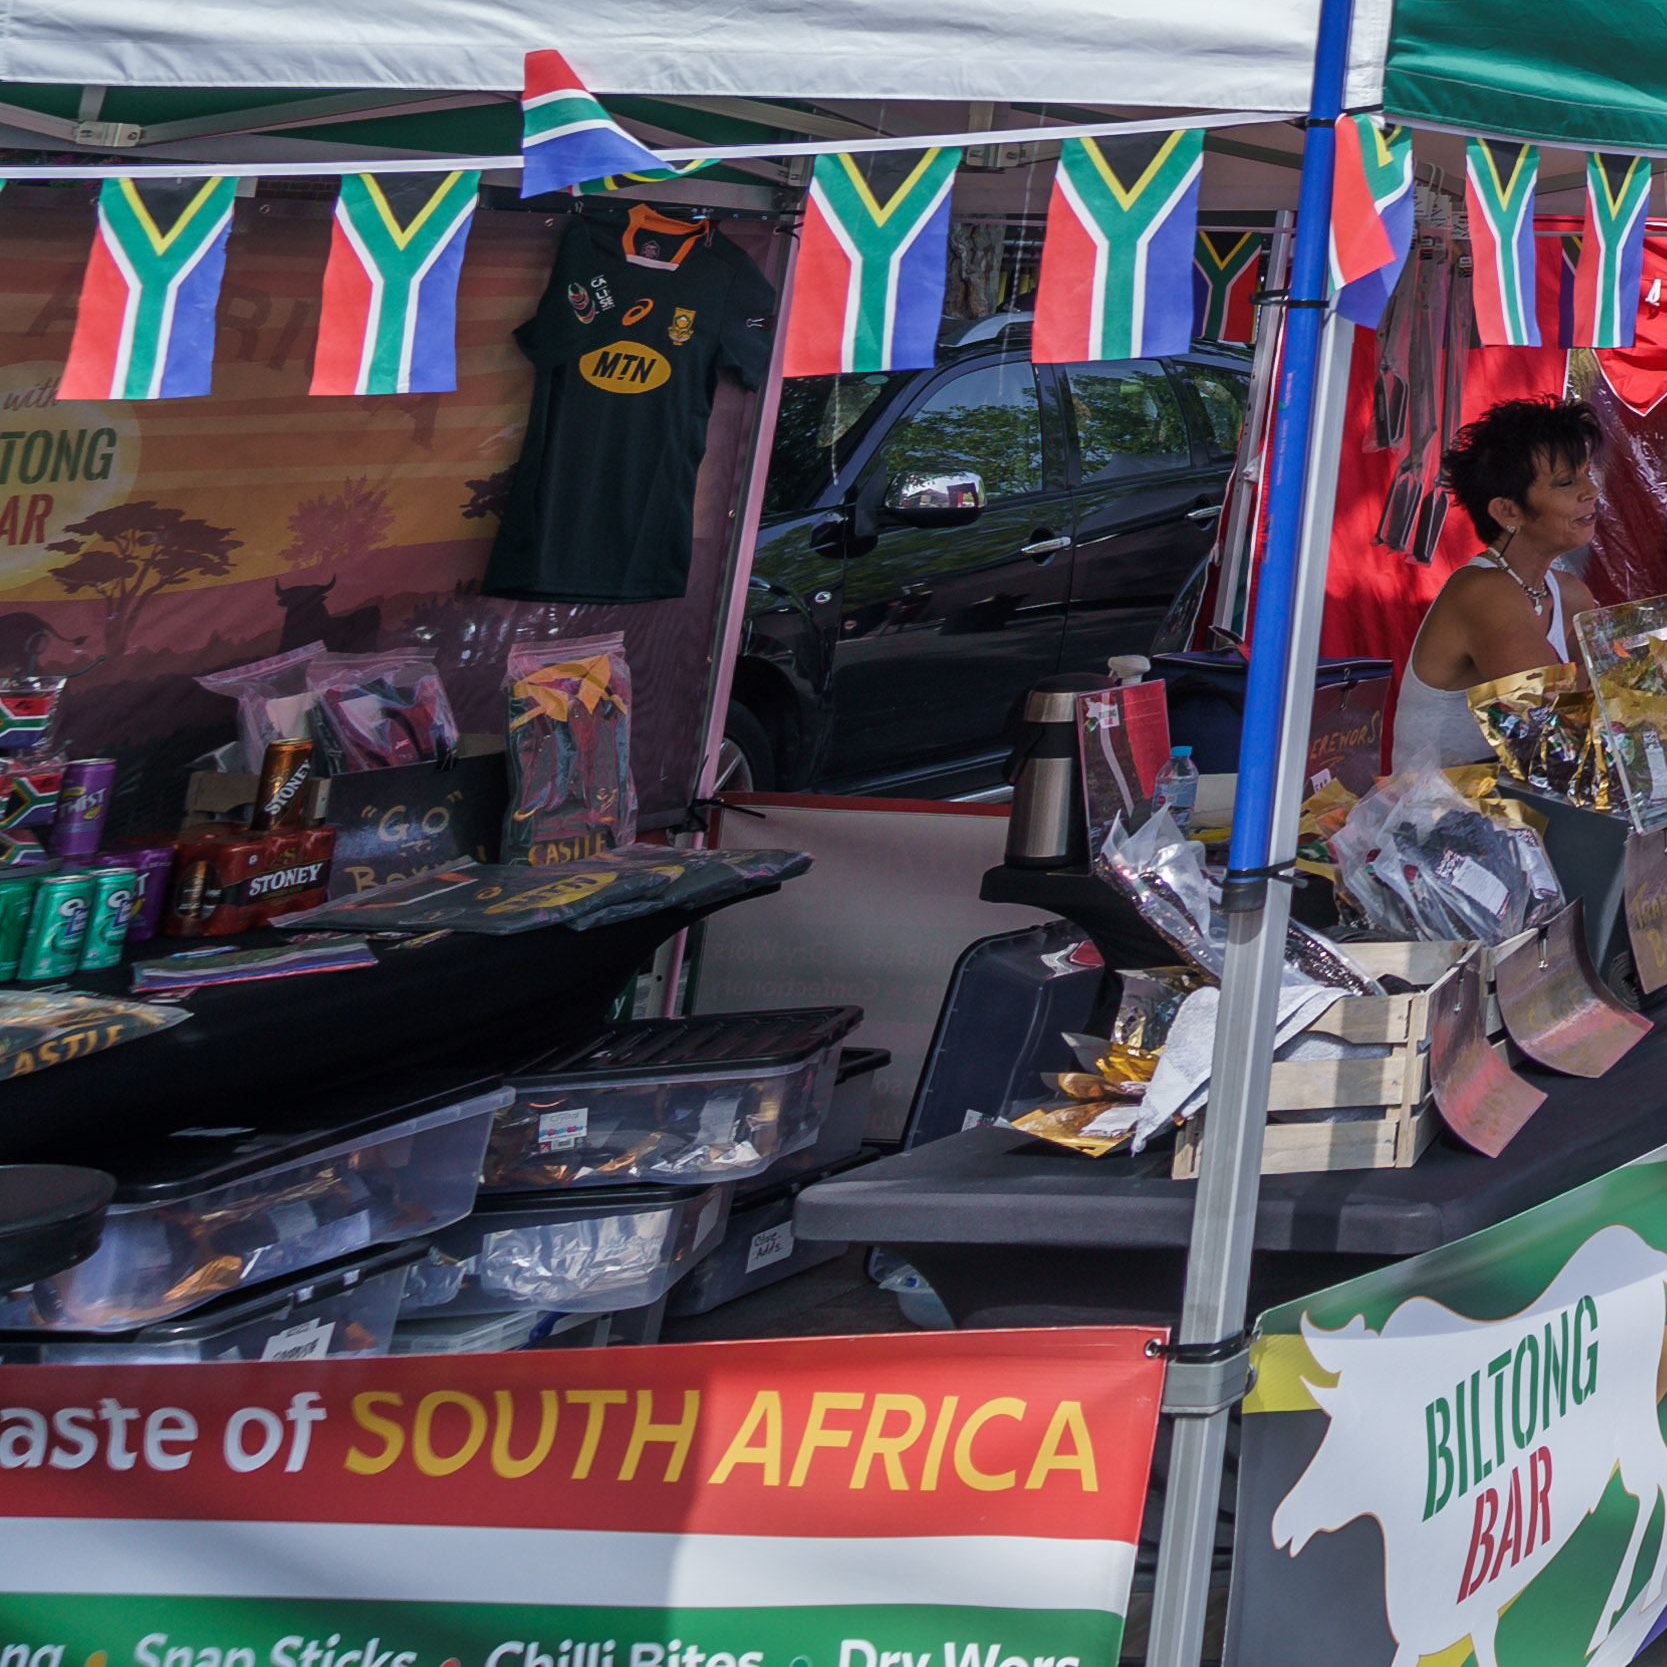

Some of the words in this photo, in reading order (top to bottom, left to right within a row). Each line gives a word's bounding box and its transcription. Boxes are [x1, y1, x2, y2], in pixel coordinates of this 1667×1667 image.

[592, 350, 657, 383] MTN
[1310, 709, 1380, 761] EREWORS
[264, 757, 312, 816] STONEY
[249, 863, 324, 896] STONEY
[1421, 1294, 1600, 1522] BILTONG
[222, 1391, 327, 1473] of
[343, 1389, 700, 1483] SOUTH
[706, 1390, 1099, 1492] AFRICA
[1456, 1445, 1554, 1605] BAR
